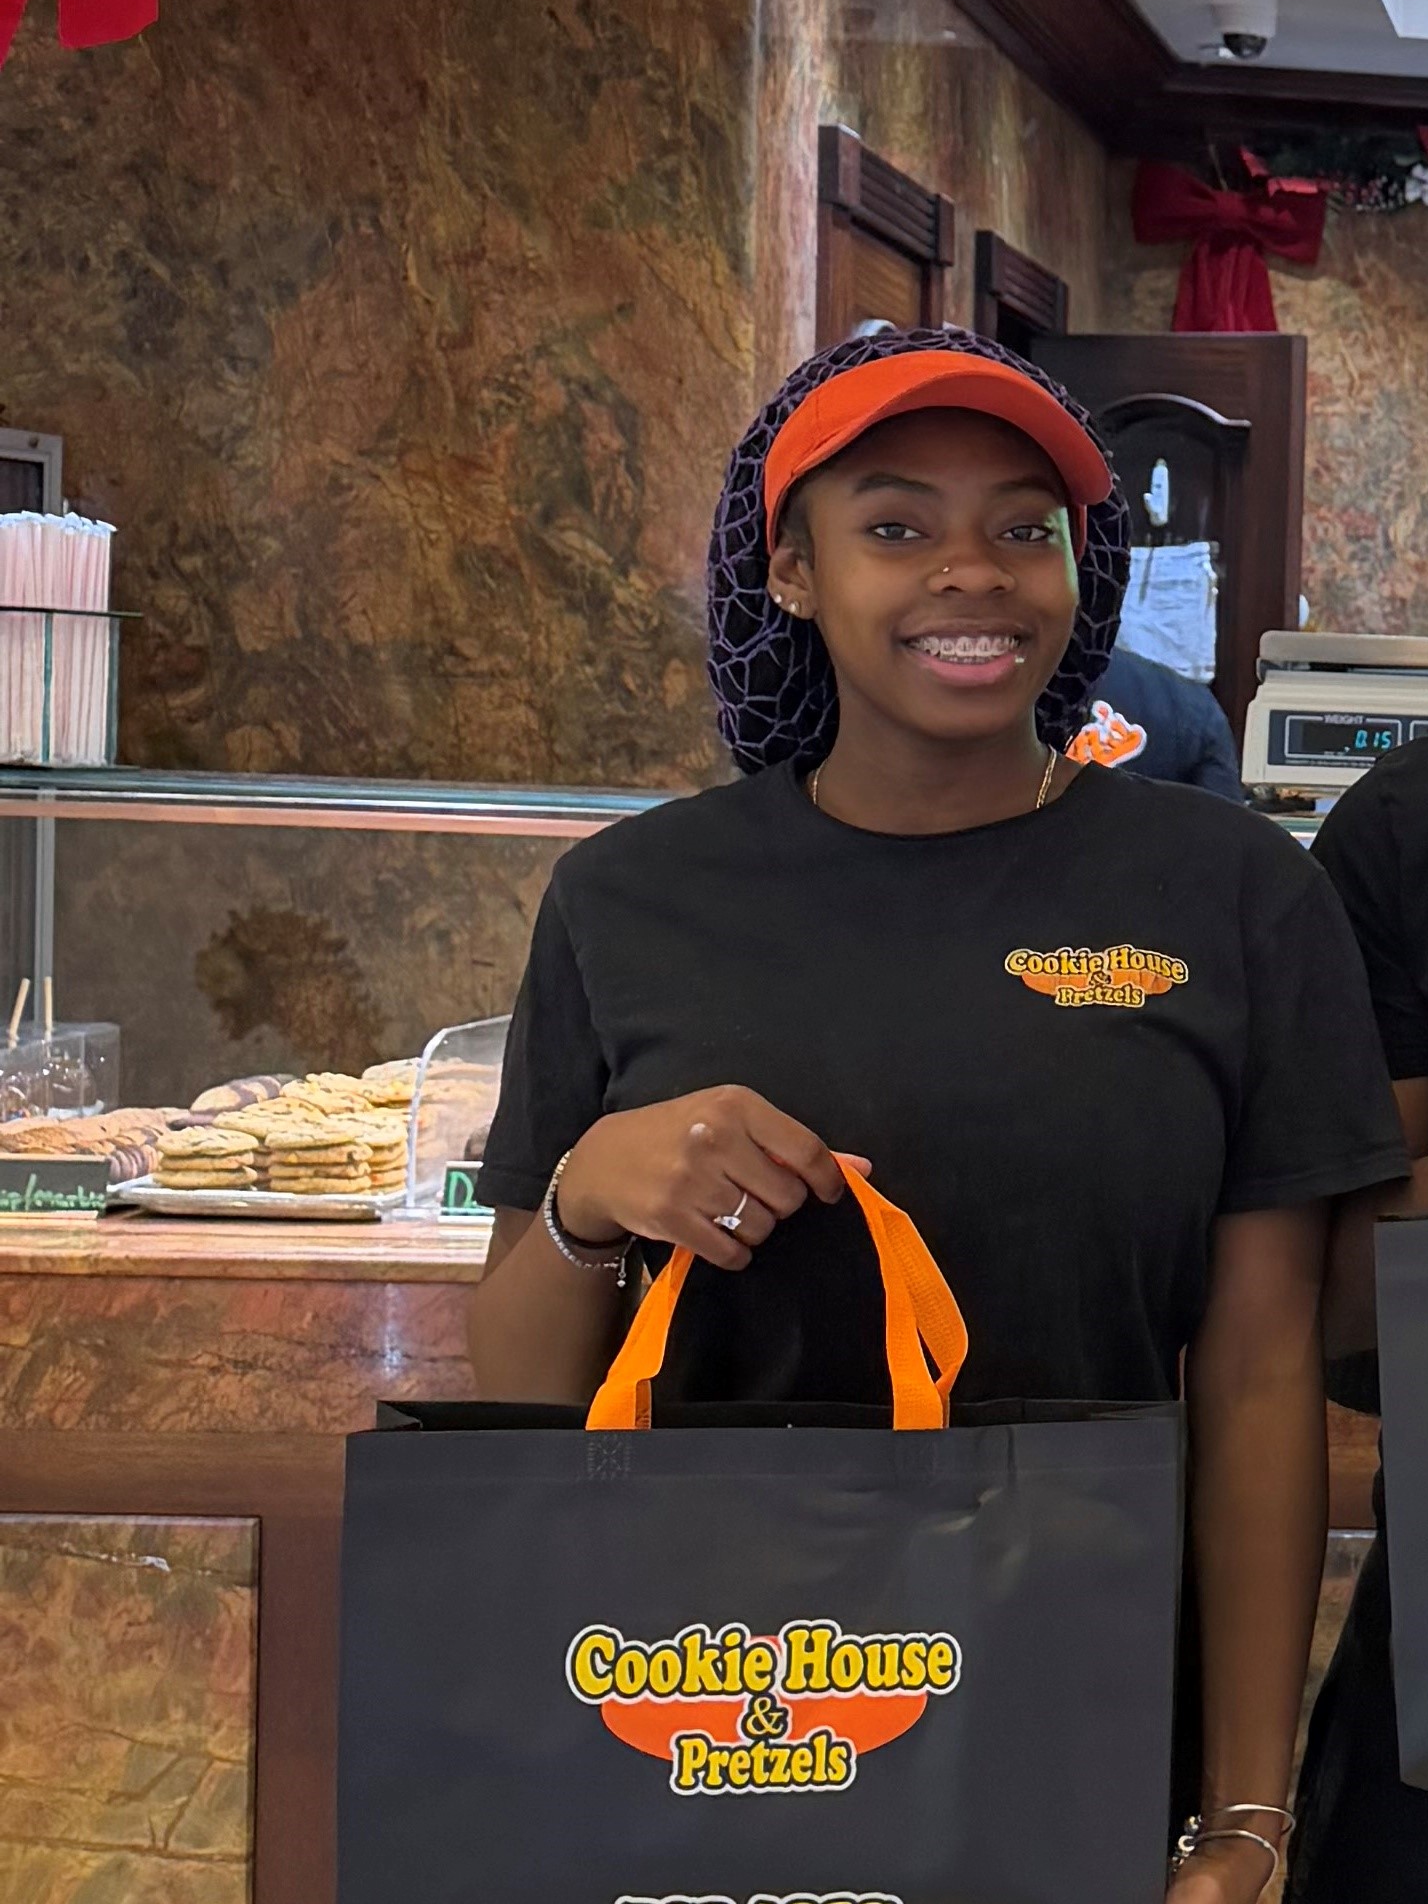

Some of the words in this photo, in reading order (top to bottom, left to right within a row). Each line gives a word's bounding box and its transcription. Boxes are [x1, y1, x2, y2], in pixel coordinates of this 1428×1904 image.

[1007, 950, 1104, 975] Cookie
[1107, 946, 1186, 980] House
[1058, 983, 1143, 1006] Pretzels
[572, 1630, 776, 1697] Cookie
[783, 1627, 957, 1691] House
[744, 1695, 784, 1737] &
[676, 1732, 850, 1788] Pretzels
